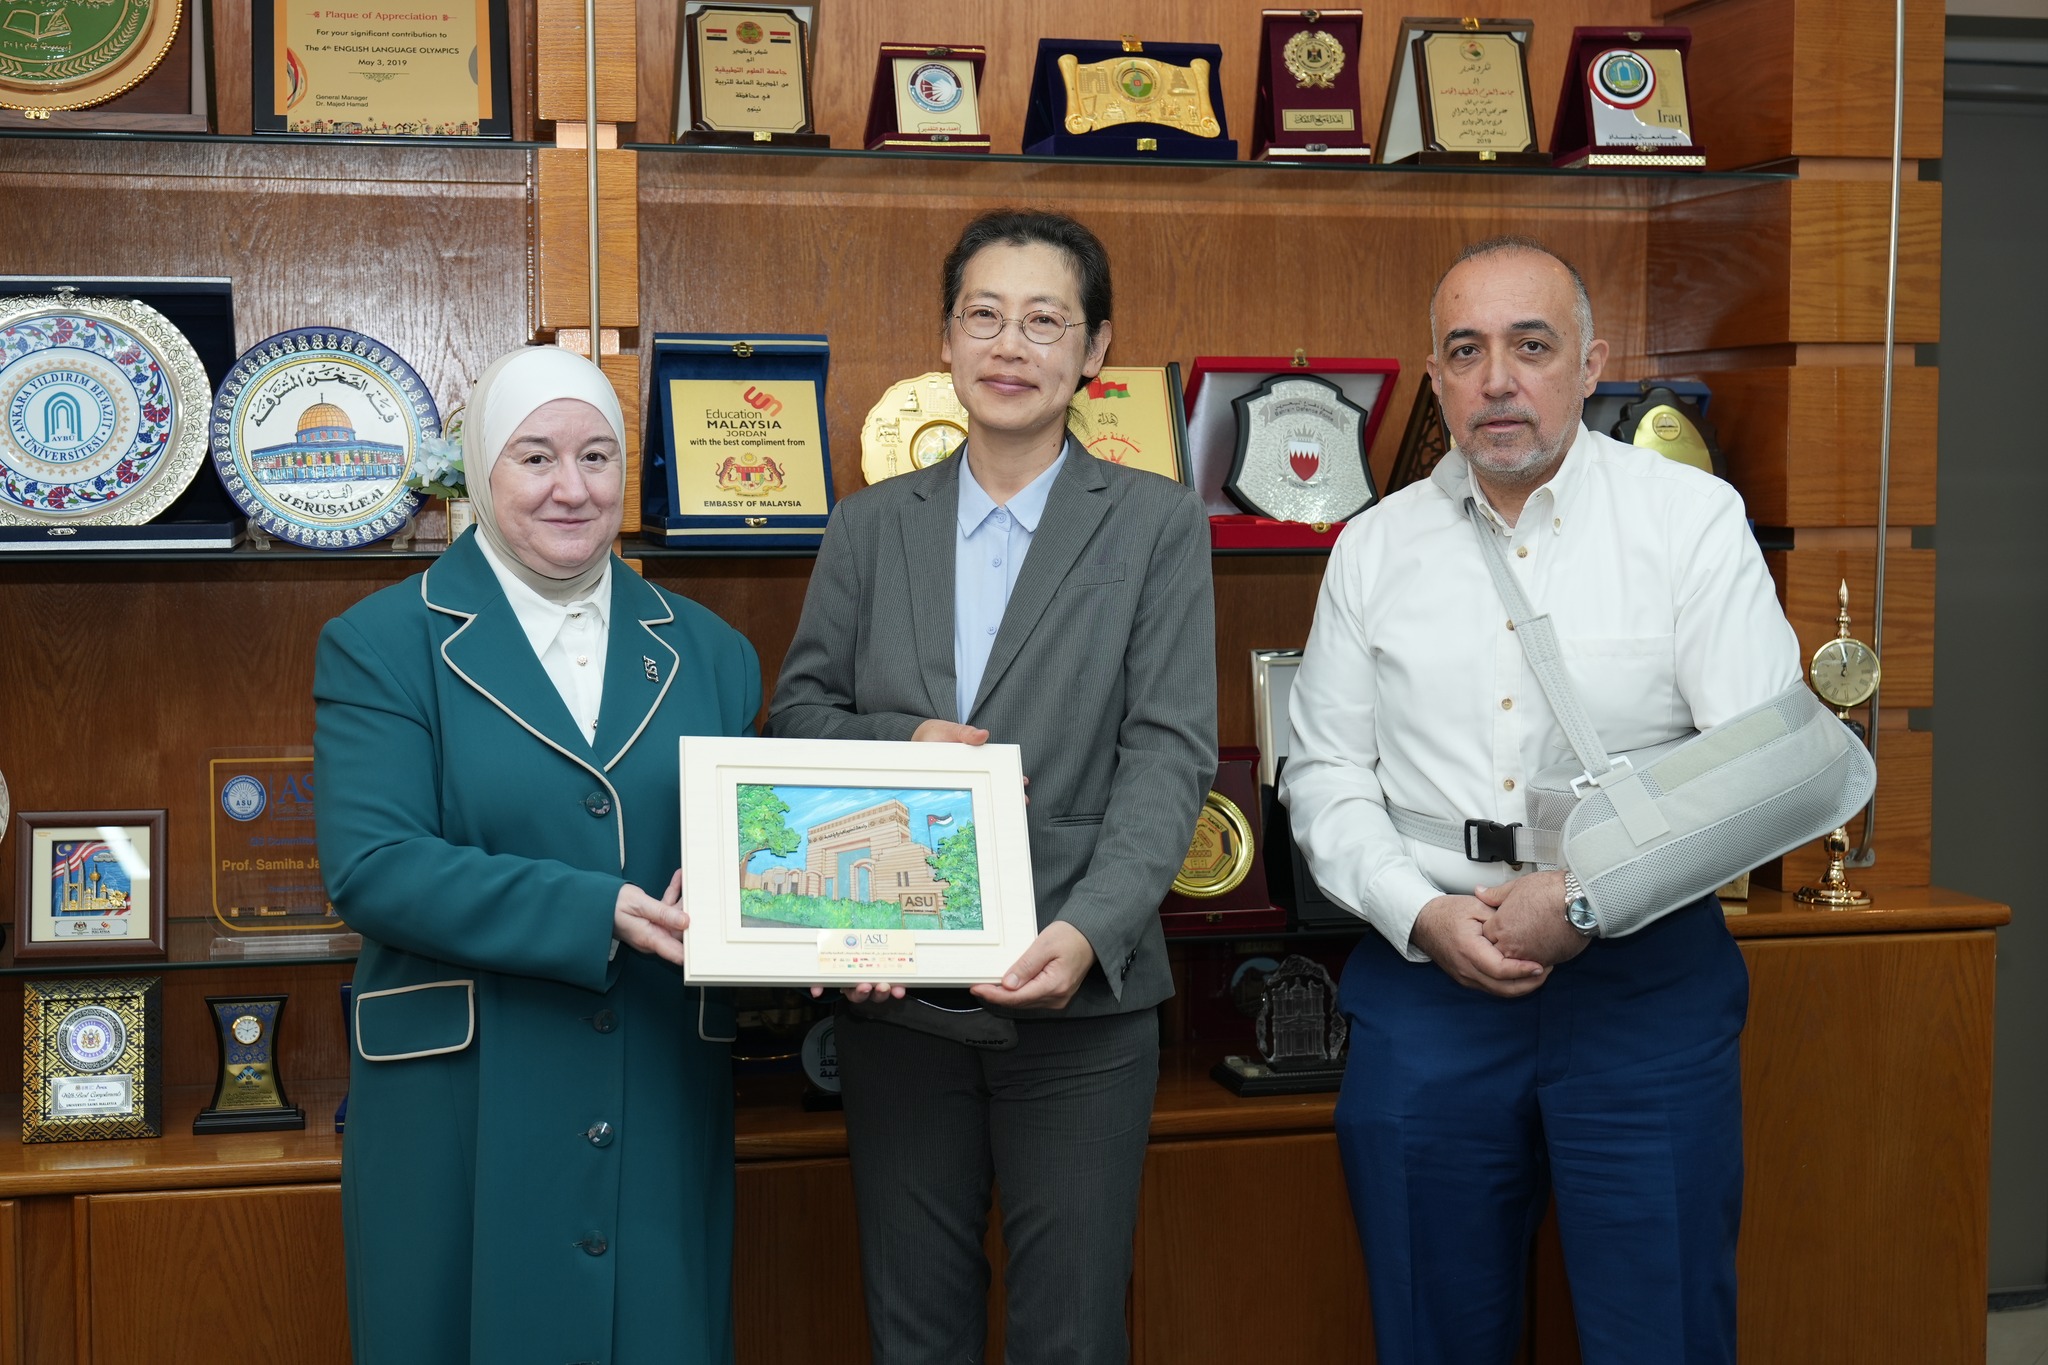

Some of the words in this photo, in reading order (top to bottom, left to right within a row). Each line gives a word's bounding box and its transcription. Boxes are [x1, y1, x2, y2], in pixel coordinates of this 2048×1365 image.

[325, 11, 359, 20] Plaque
[375, 12, 438, 21] Appreciation
[351, 30, 389, 38] significant
[358, 59, 374, 67] May
[377, 59, 384, 67] 3,
[715, 78, 734, 86] للتربية
[1658, 109, 1682, 128] Iraq
[12, 388, 31, 433] ANKARA
[31, 373, 90, 393] YILDIRIM
[90, 382, 114, 430] BEYAZIT
[706, 409, 762, 419] Education
[1274, 407, 1294, 416] Bahrain
[1319, 411, 1334, 422] Force
[707, 420, 782, 429] MALAYSIA
[51, 434, 76, 442] AYBÜ
[23, 435, 105, 462] ÜNİVERSİTESİ
[741, 439, 785, 448] compliment
[306, 484, 352, 500] القدس
[279, 488, 385, 516] JERUSALEM
[278, 774, 315, 804] AS
[222, 860, 252, 871] Prof.
[256, 858, 304, 870] Samiha
[308, 858, 320, 869] Ja
[905, 896, 933, 907] ASU
[865, 934, 888, 944] ASU
